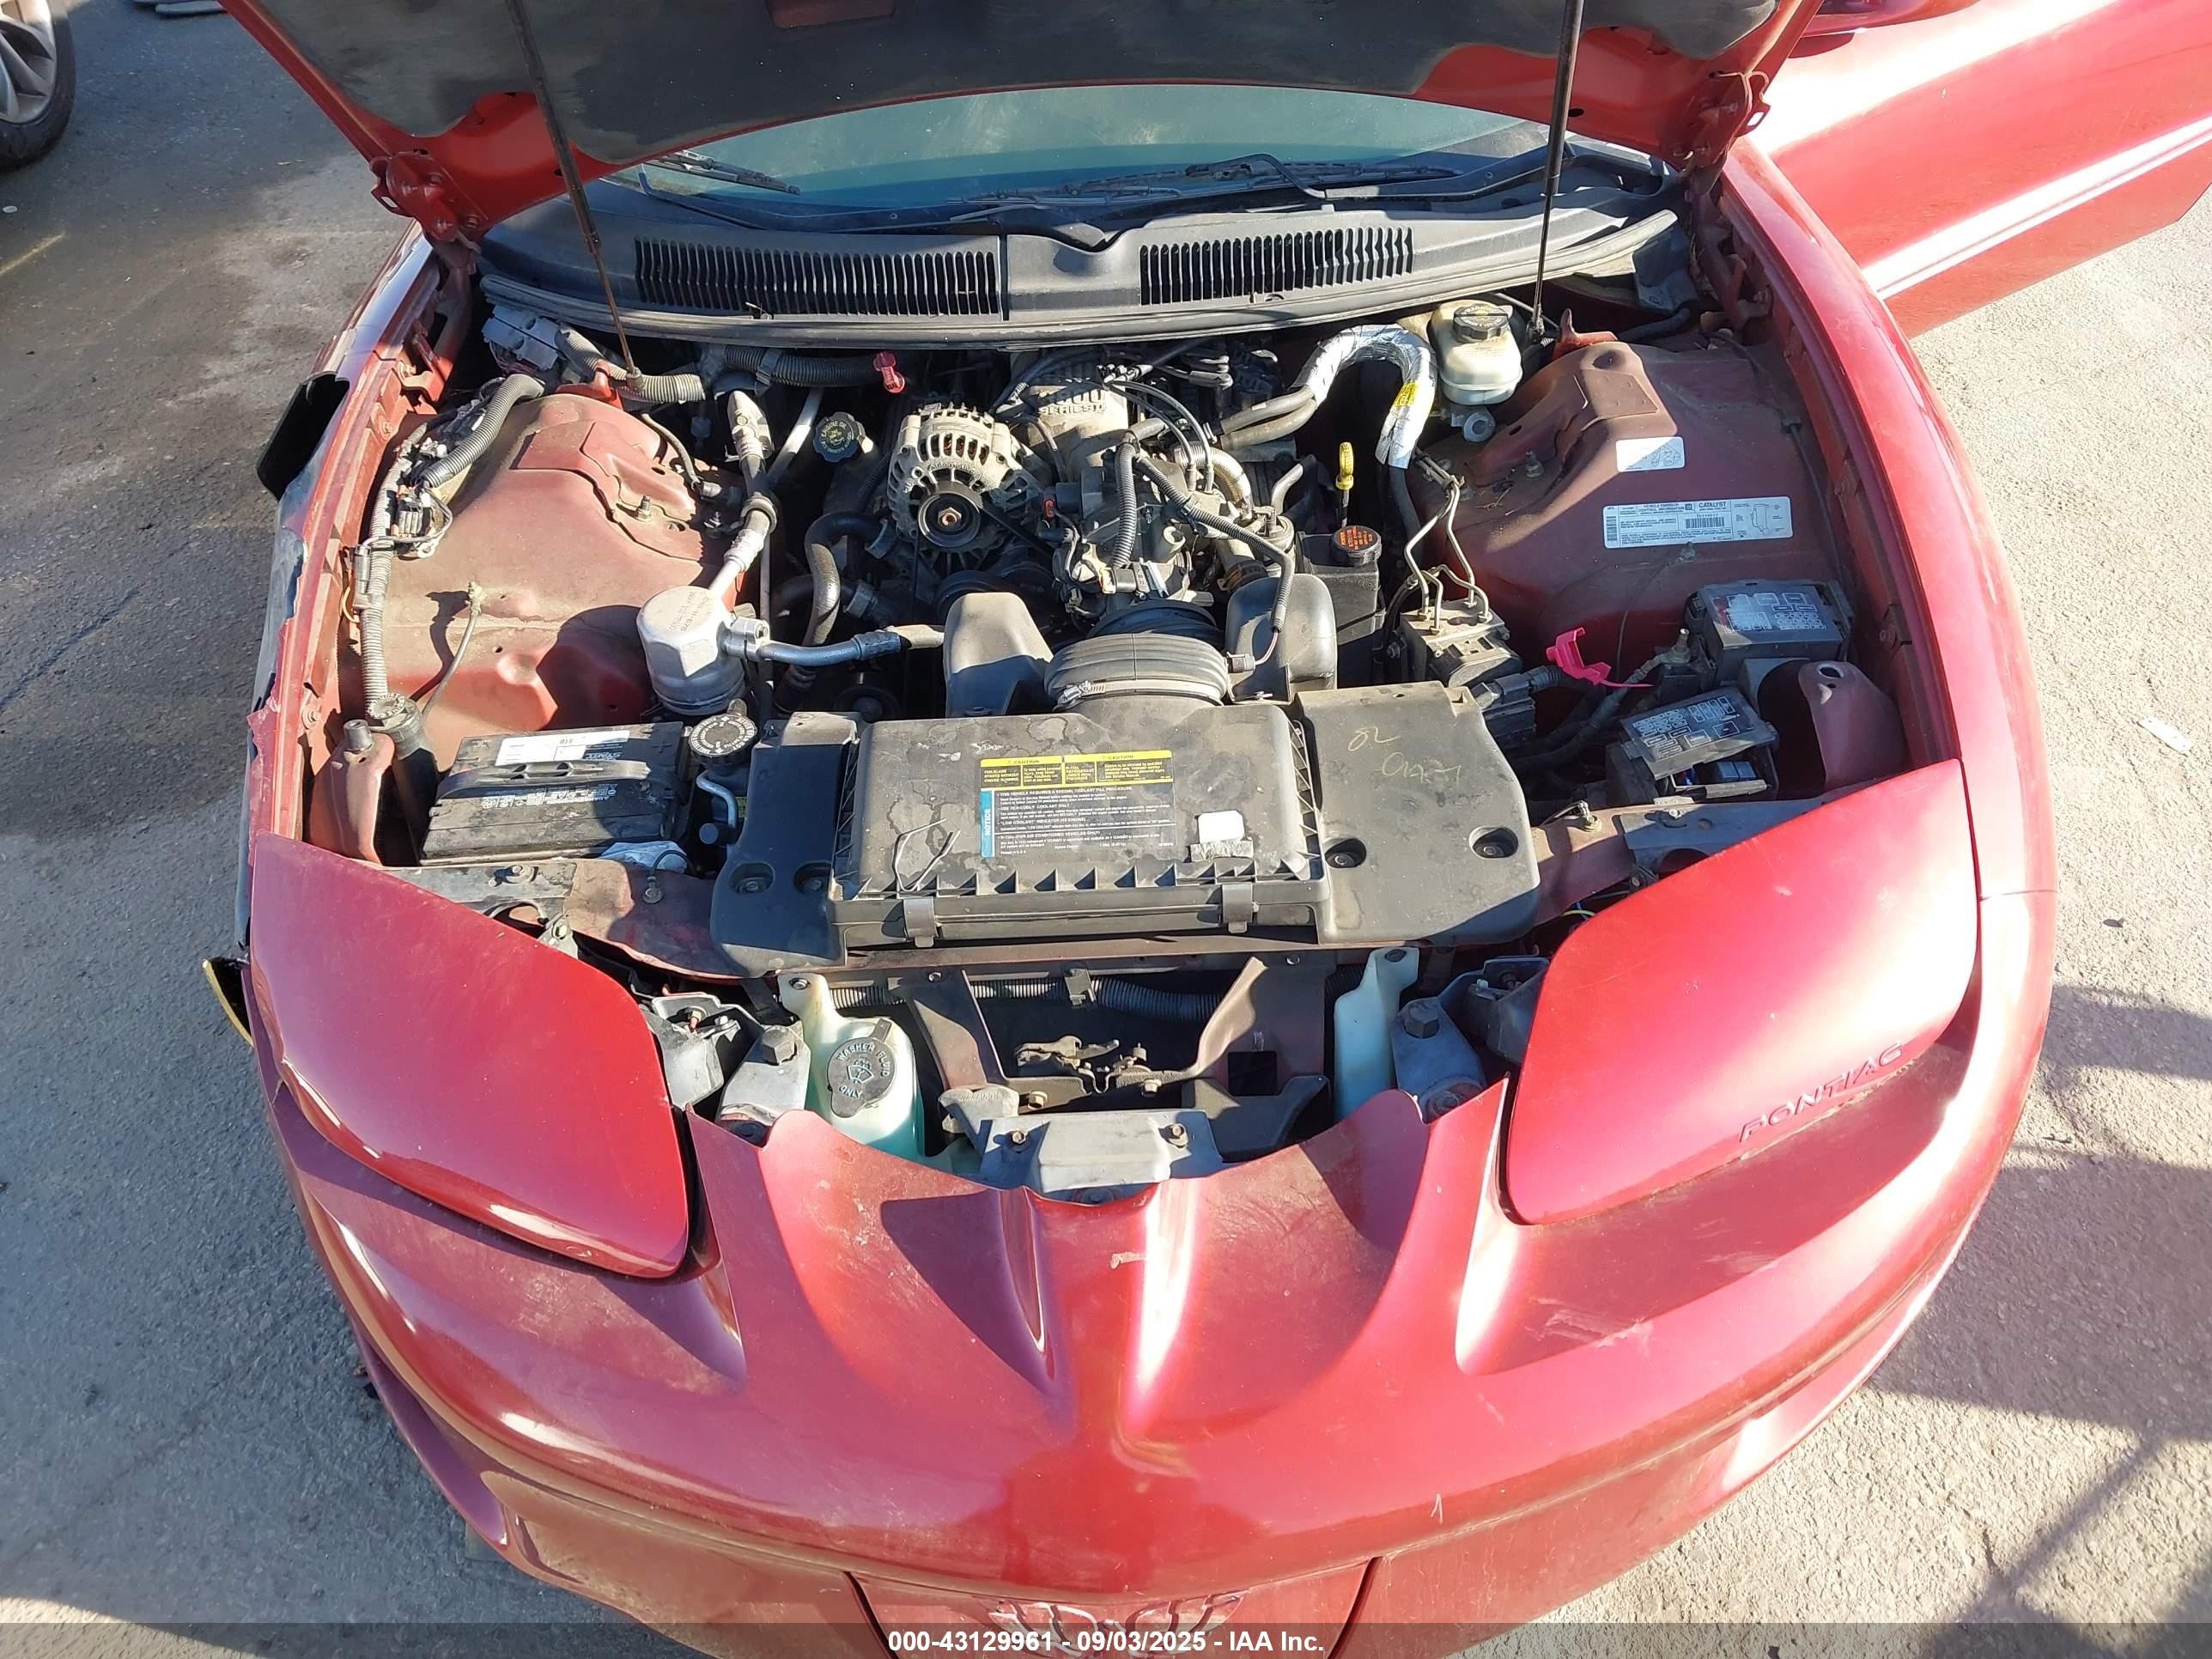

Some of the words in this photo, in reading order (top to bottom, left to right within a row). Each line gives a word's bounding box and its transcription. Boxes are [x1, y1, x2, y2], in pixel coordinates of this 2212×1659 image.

[836, 1042, 876, 1061] WASHER
[876, 1051, 890, 1077] FLUID
[838, 1085, 863, 1098] ONLY
[1738, 1039, 1904, 1143] PONTIAC
